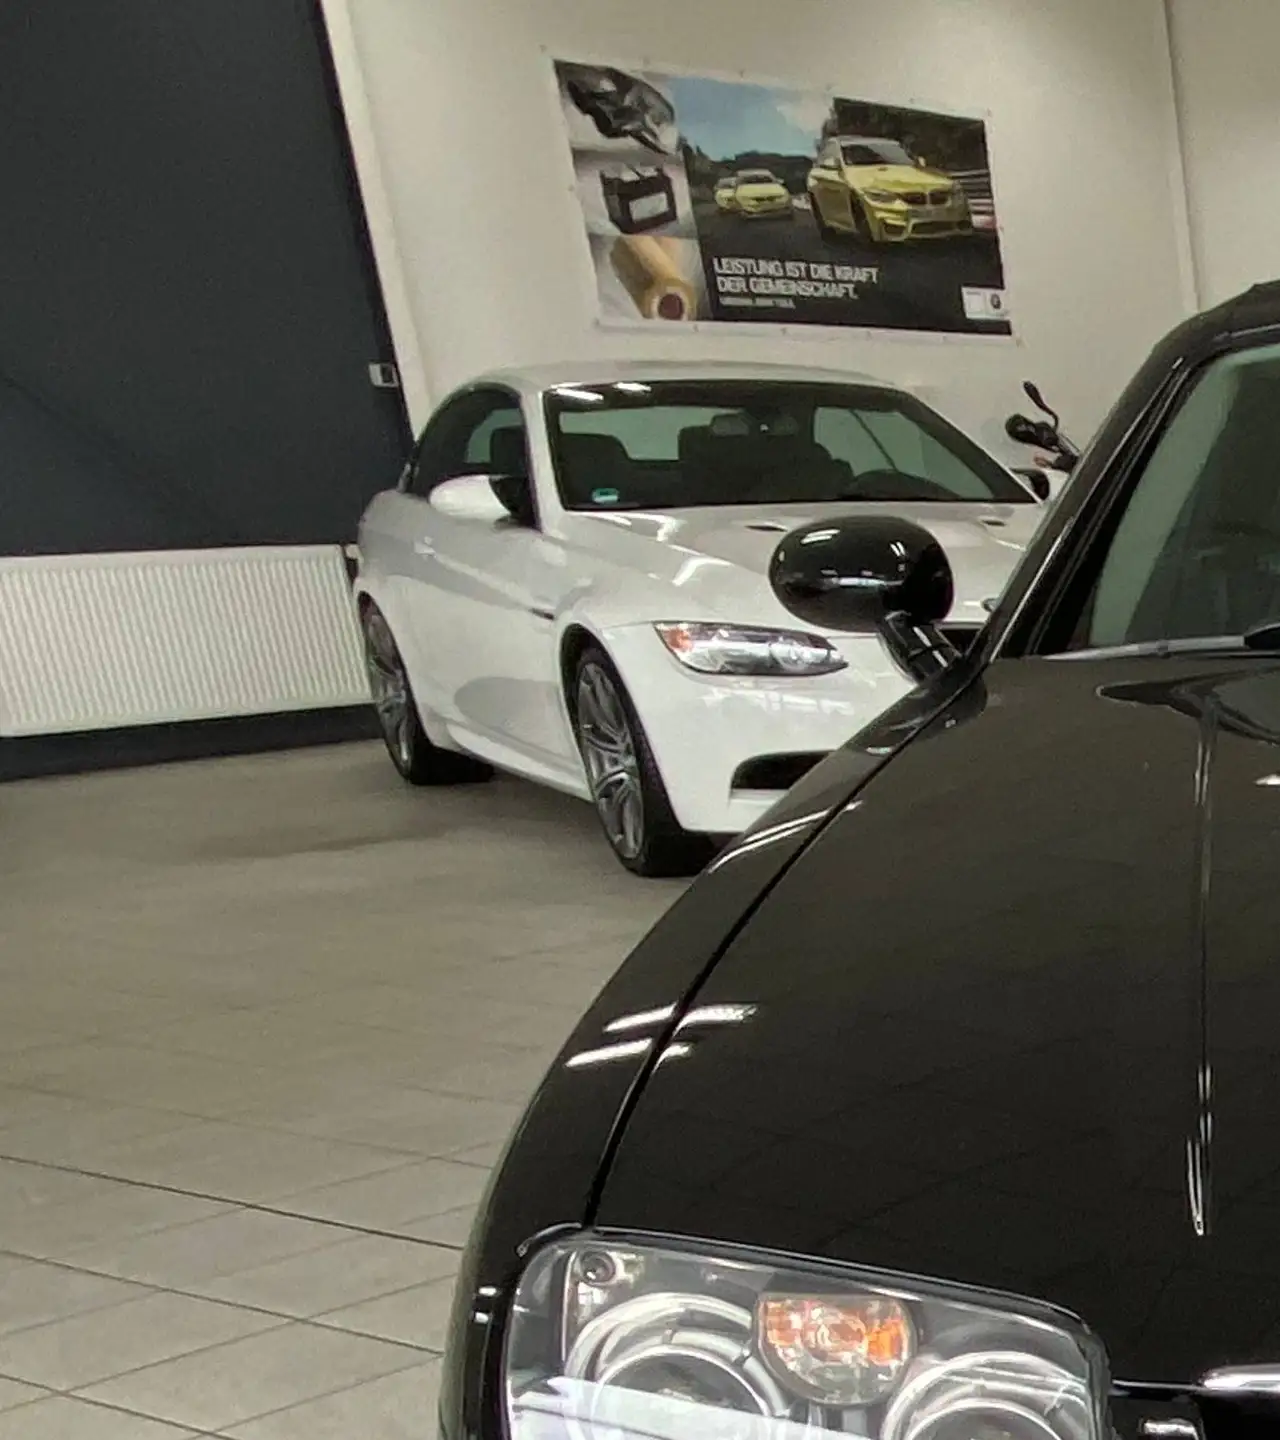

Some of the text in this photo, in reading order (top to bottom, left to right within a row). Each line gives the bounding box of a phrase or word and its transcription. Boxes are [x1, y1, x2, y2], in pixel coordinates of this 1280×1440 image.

[712, 257, 879, 284] LEISTUNG IST DIE KRAFT
[716, 276, 748, 293] DER
